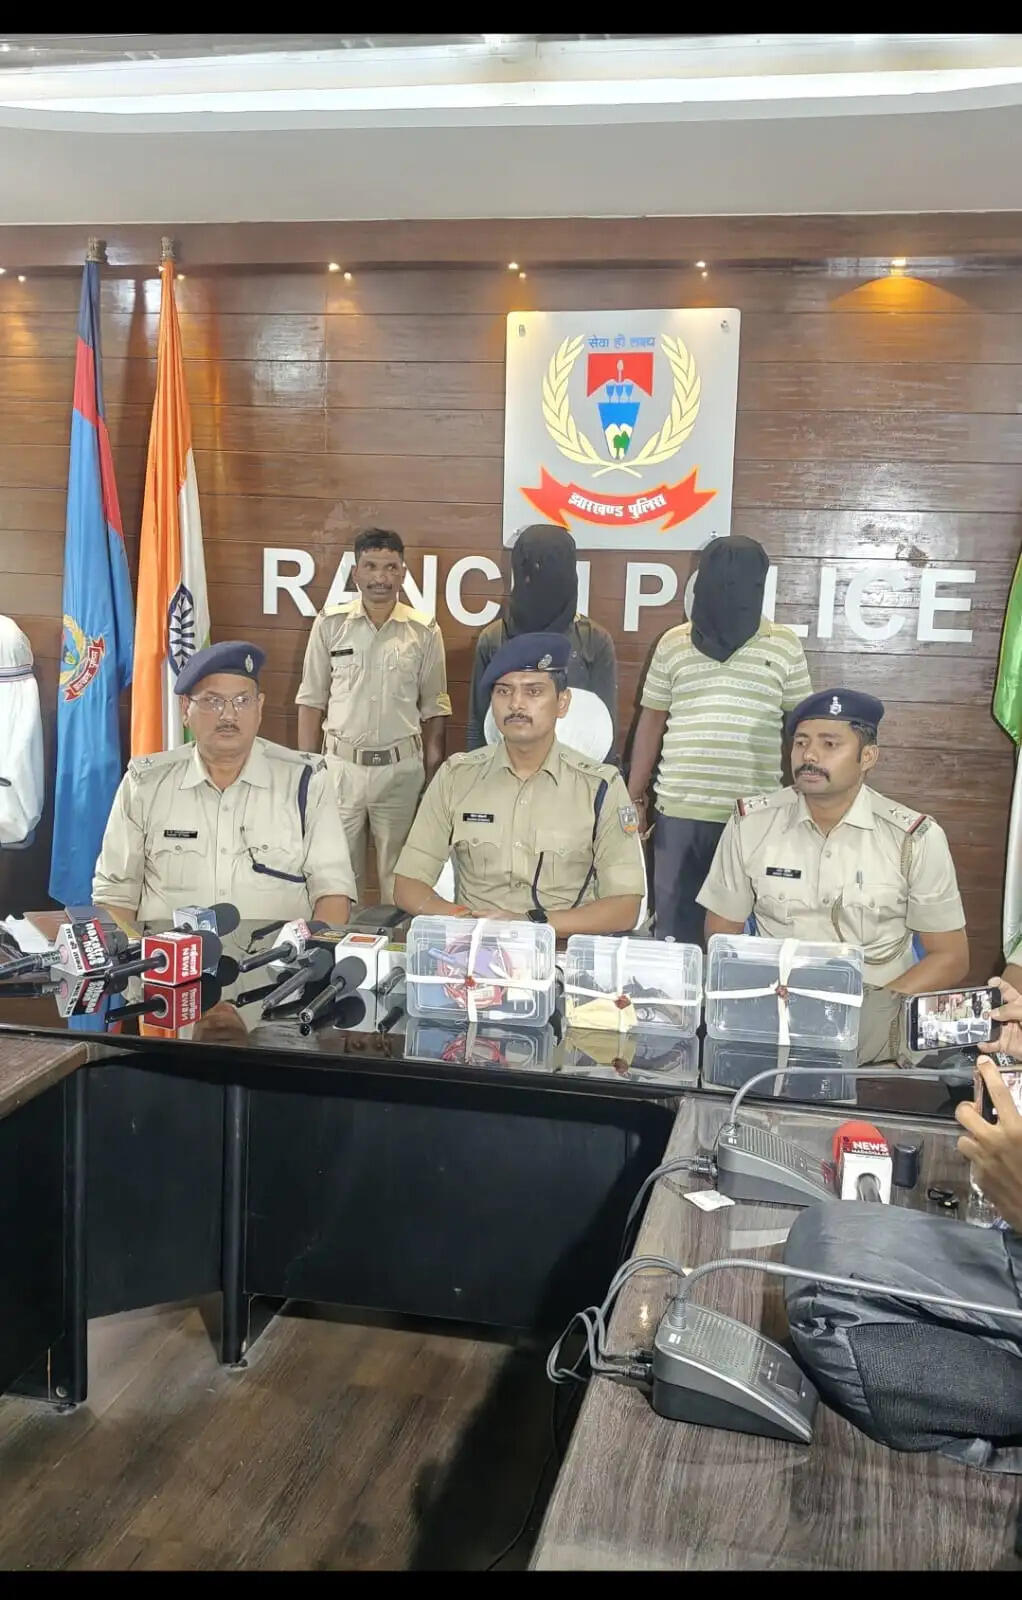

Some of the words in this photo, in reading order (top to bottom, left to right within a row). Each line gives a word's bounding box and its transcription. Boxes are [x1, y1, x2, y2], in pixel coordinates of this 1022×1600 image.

[587, 334, 609, 348] सेवा
[567, 491, 624, 517] झारखण्ड
[627, 493, 667, 520] पुलिस
[623, 562, 977, 643] PLICE
[181, 947, 190, 977] NEWS
[852, 1140, 889, 1152] NEWS
